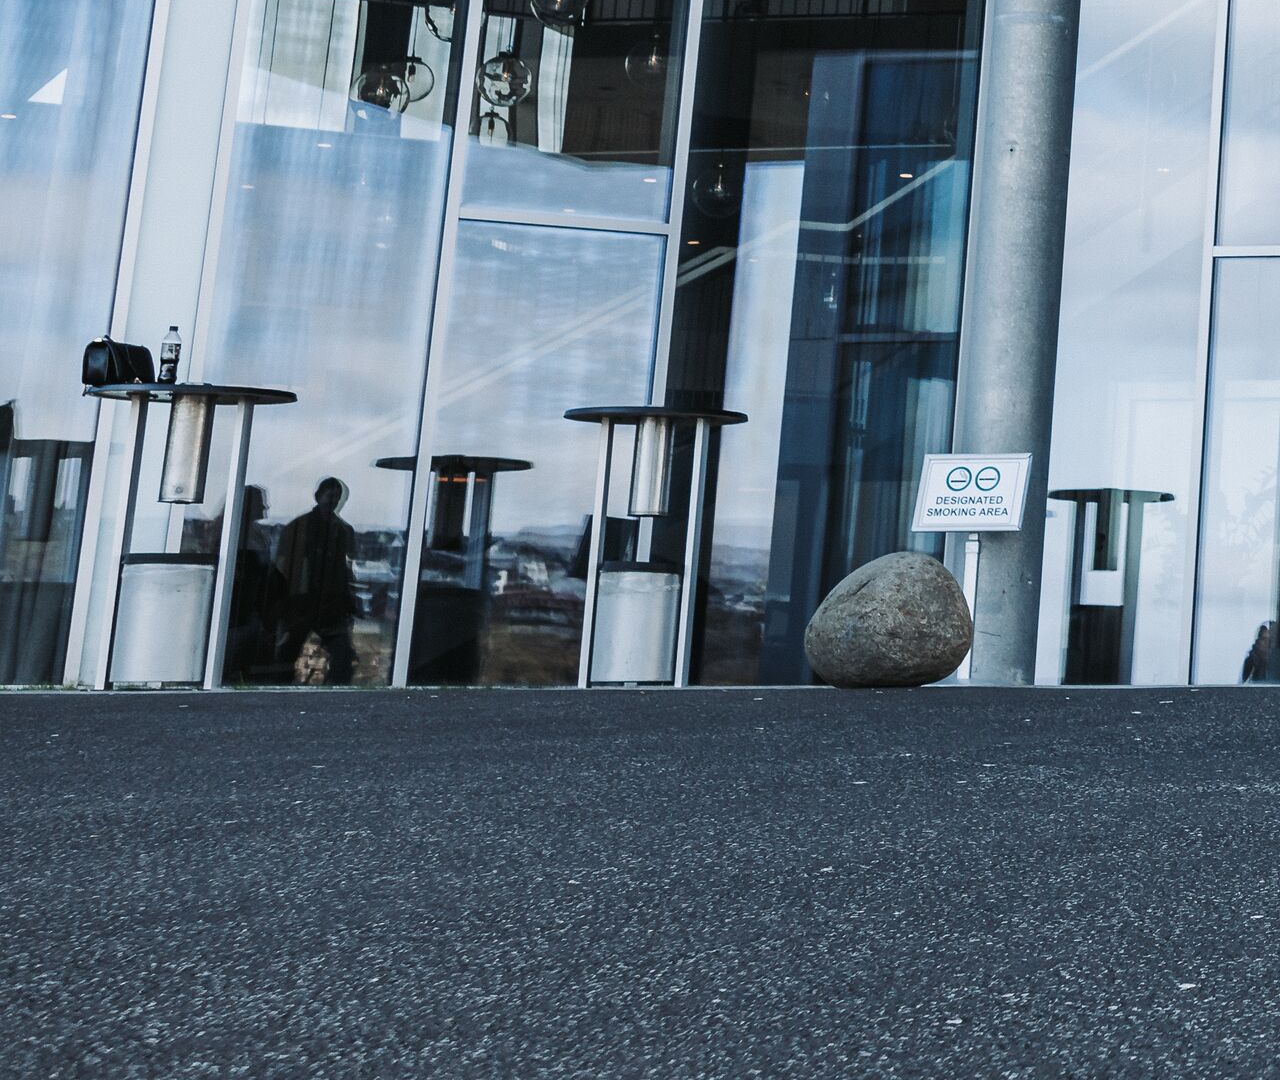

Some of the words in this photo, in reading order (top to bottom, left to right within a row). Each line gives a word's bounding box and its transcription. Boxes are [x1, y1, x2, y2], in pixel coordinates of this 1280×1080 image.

[935, 495, 1004, 505] DESIGNATED
[926, 508, 977, 517] SMOKING
[979, 507, 1009, 516] AREA
